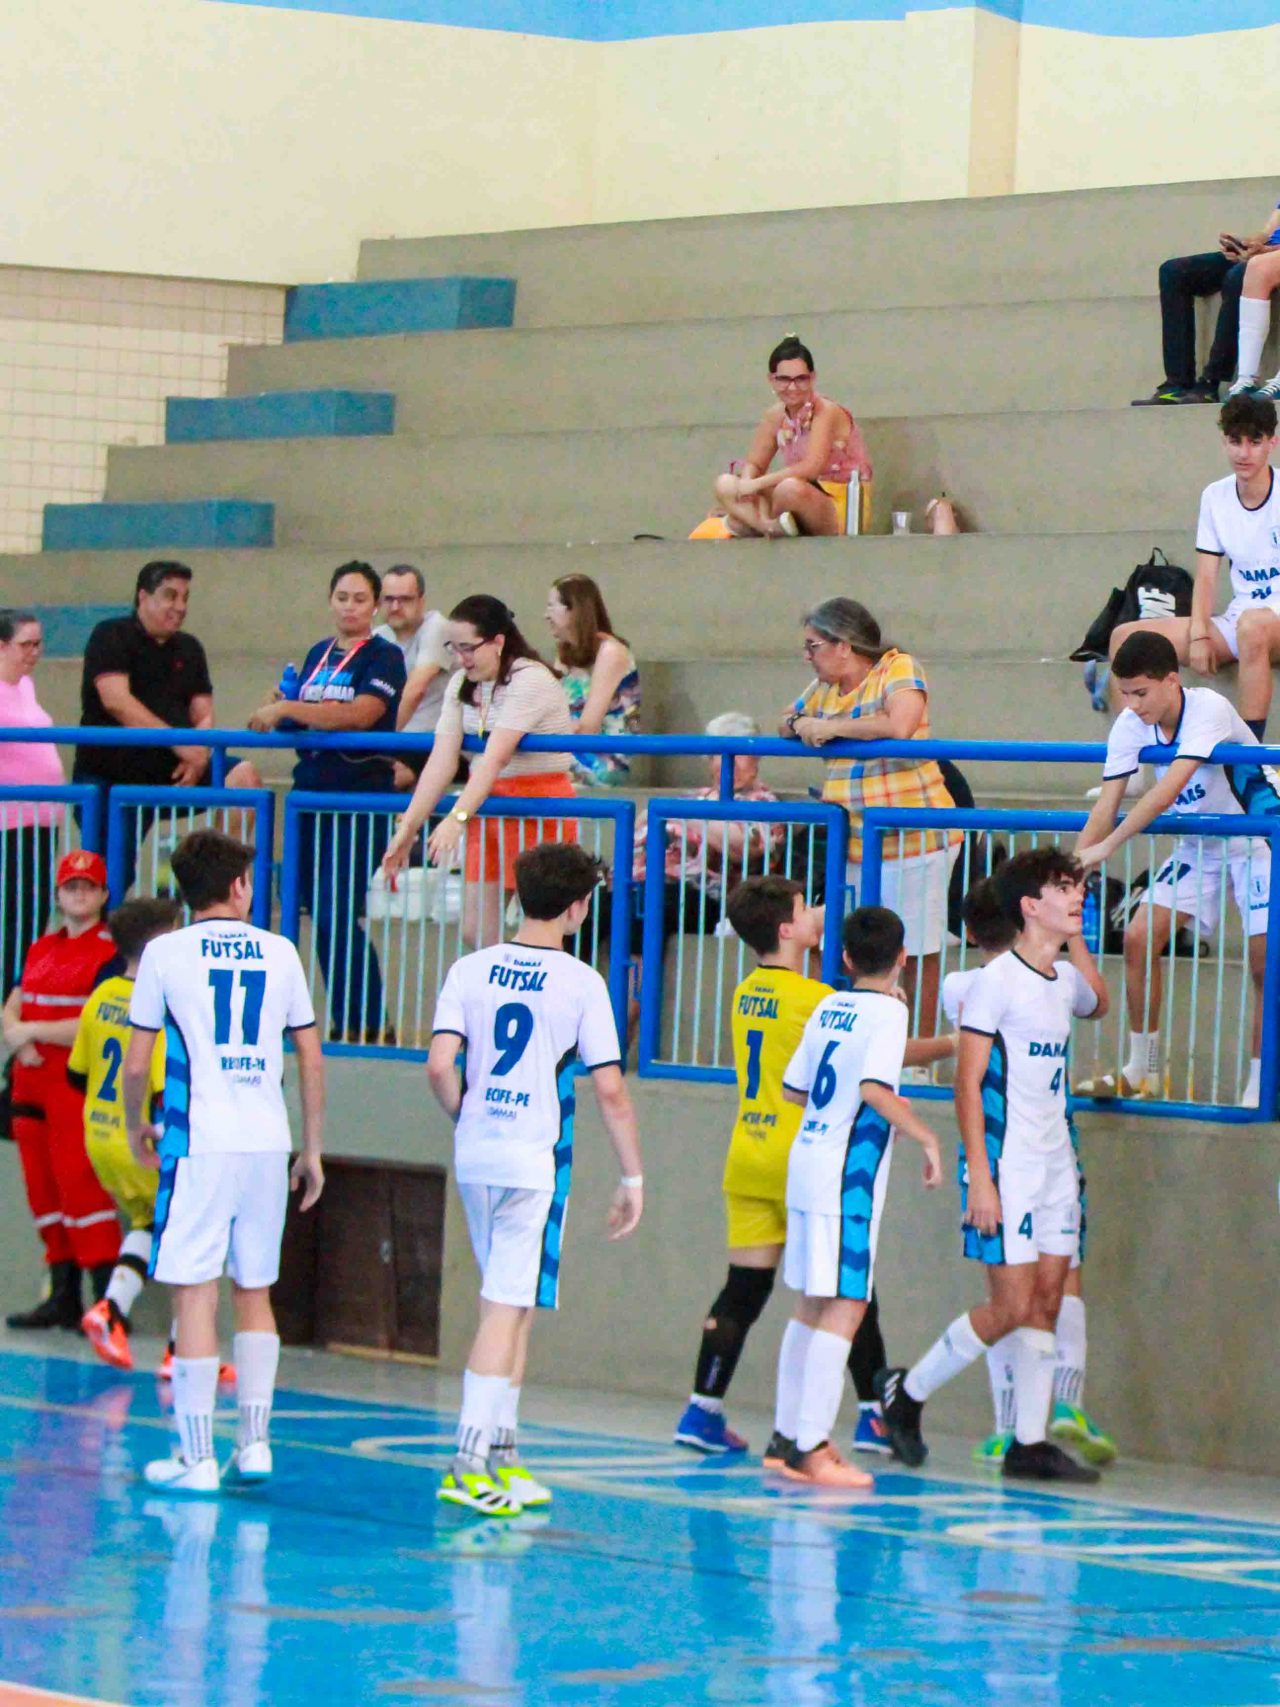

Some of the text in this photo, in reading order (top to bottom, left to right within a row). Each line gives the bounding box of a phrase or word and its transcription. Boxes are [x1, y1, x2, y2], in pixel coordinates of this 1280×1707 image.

[201, 938, 264, 960] FUTSAL
[488, 964, 548, 992] FUTSAL
[208, 968, 267, 1046] 11
[737, 994, 779, 1020] FUTSAL
[819, 1010, 858, 1032] FUTSAL
[491, 1002, 534, 1076] 9
[96, 1037, 123, 1102] 2
[745, 1029, 764, 1100] 1
[811, 1040, 841, 1111] 6
[1050, 1067, 1063, 1096] 4
[1018, 1212, 1033, 1240] 4
